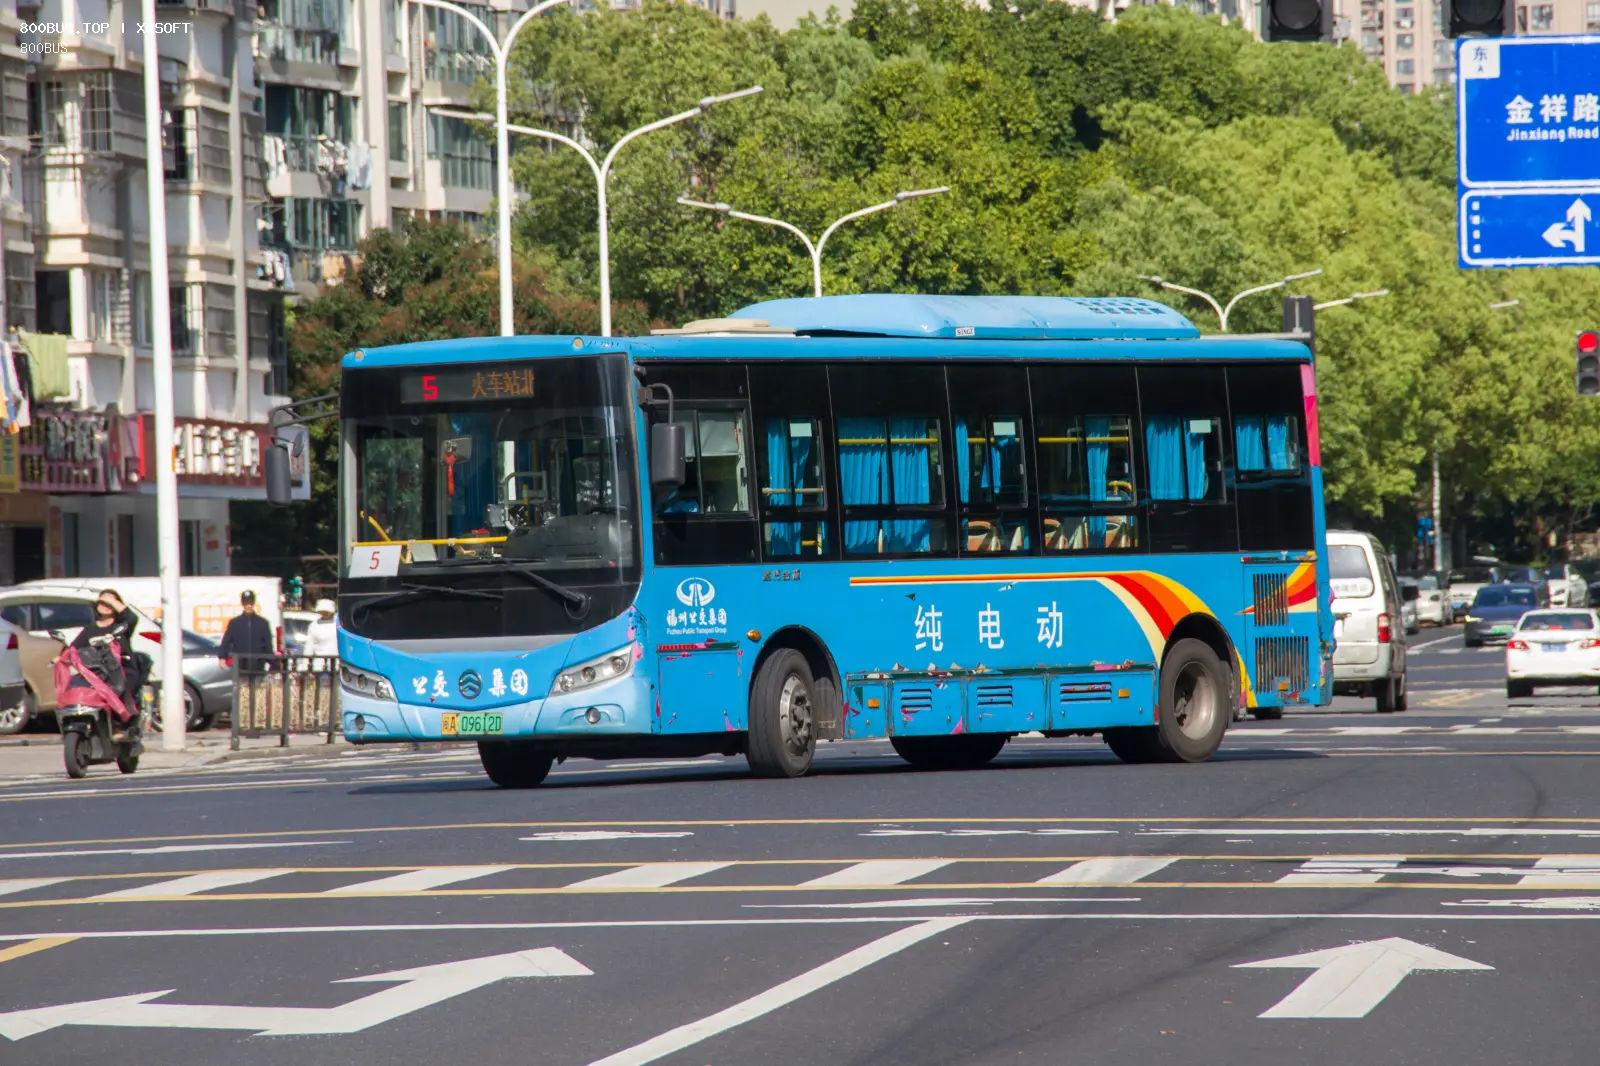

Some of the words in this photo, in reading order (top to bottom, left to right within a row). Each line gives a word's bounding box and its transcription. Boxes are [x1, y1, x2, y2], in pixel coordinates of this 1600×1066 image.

[1472, 46, 1488, 61] 东
[1505, 93, 1600, 124] 金祥路
[1506, 127, 1566, 142] Jinxiang
[1568, 125, 1599, 139] Road
[423, 375, 438, 400] 5
[472, 368, 535, 399] 火车站北
[369, 550, 380, 570] 5
